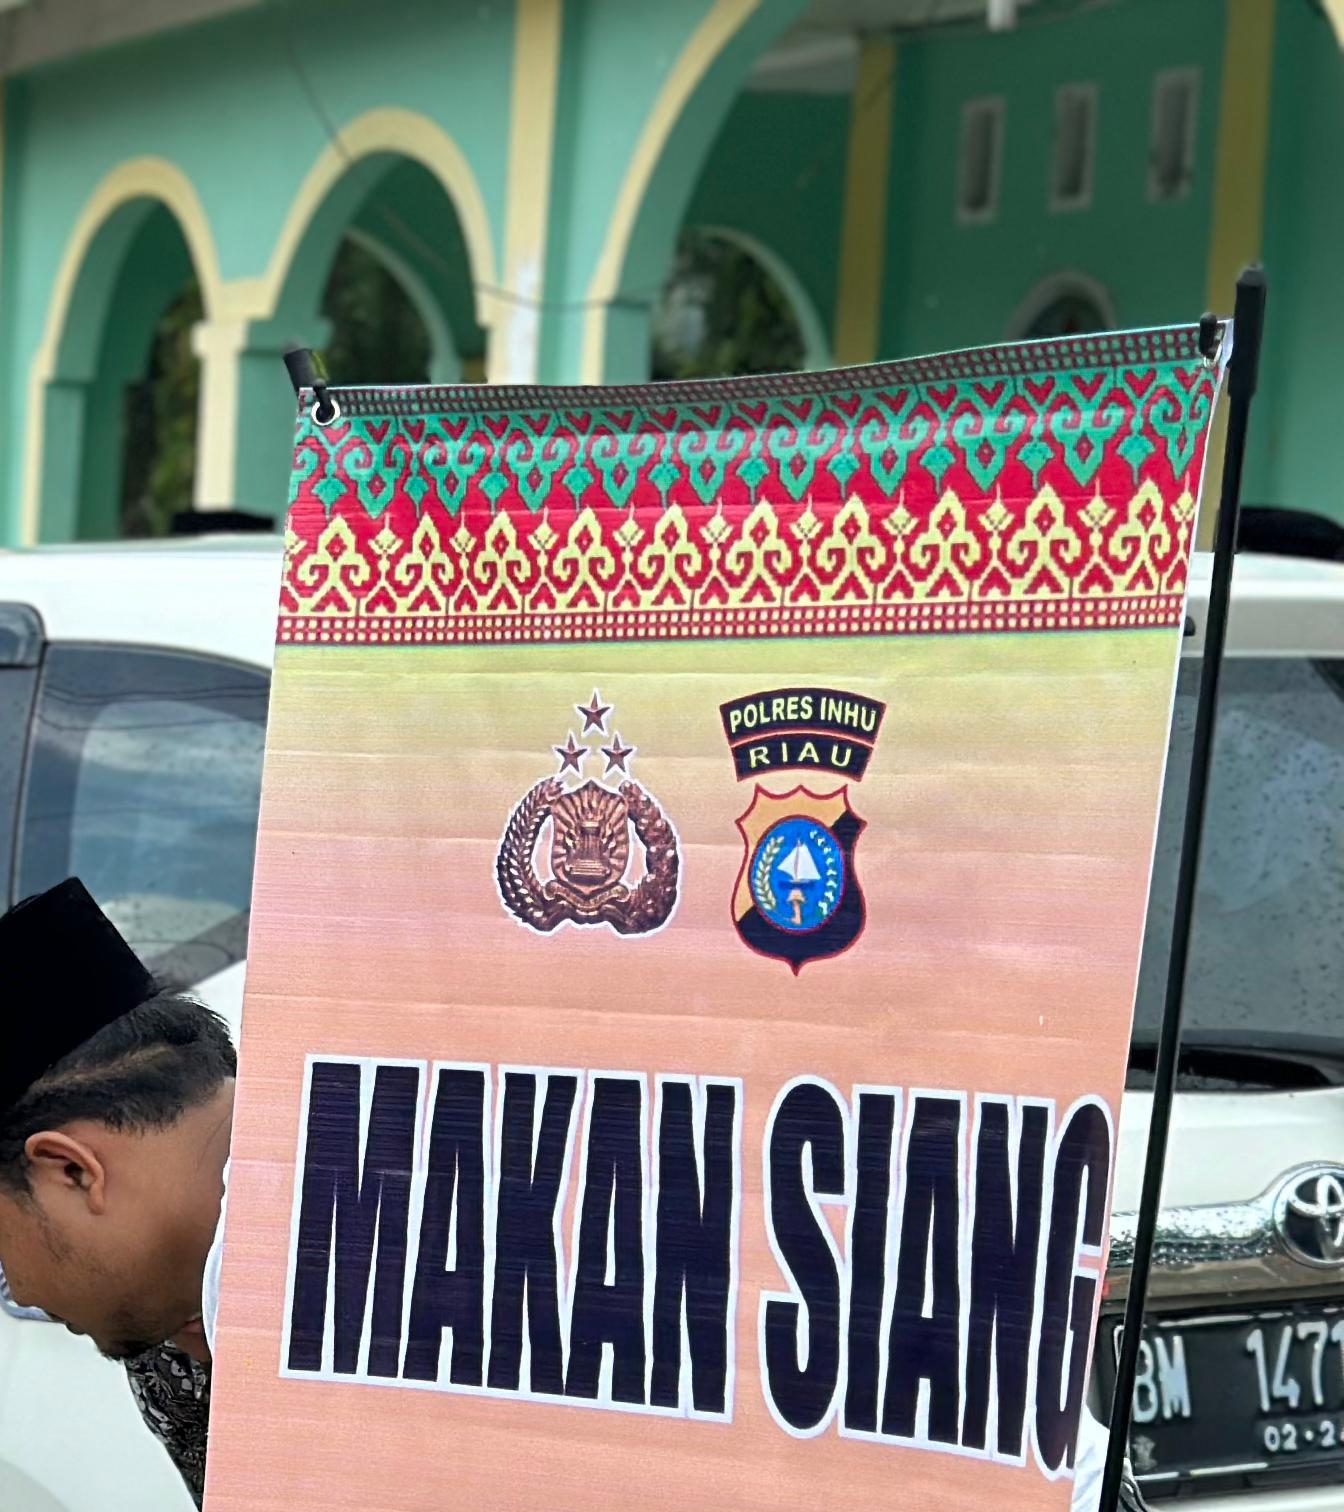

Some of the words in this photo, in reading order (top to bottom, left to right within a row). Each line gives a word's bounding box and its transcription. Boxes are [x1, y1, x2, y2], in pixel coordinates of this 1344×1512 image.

[729, 696, 813, 733] POLRES
[820, 697, 876, 731] INHU
[749, 742, 852, 768] RIAU
[284, 1058, 737, 1415] MAKAN
[763, 1080, 1110, 1474] SIANG
[1133, 1335, 1190, 1422] BM
